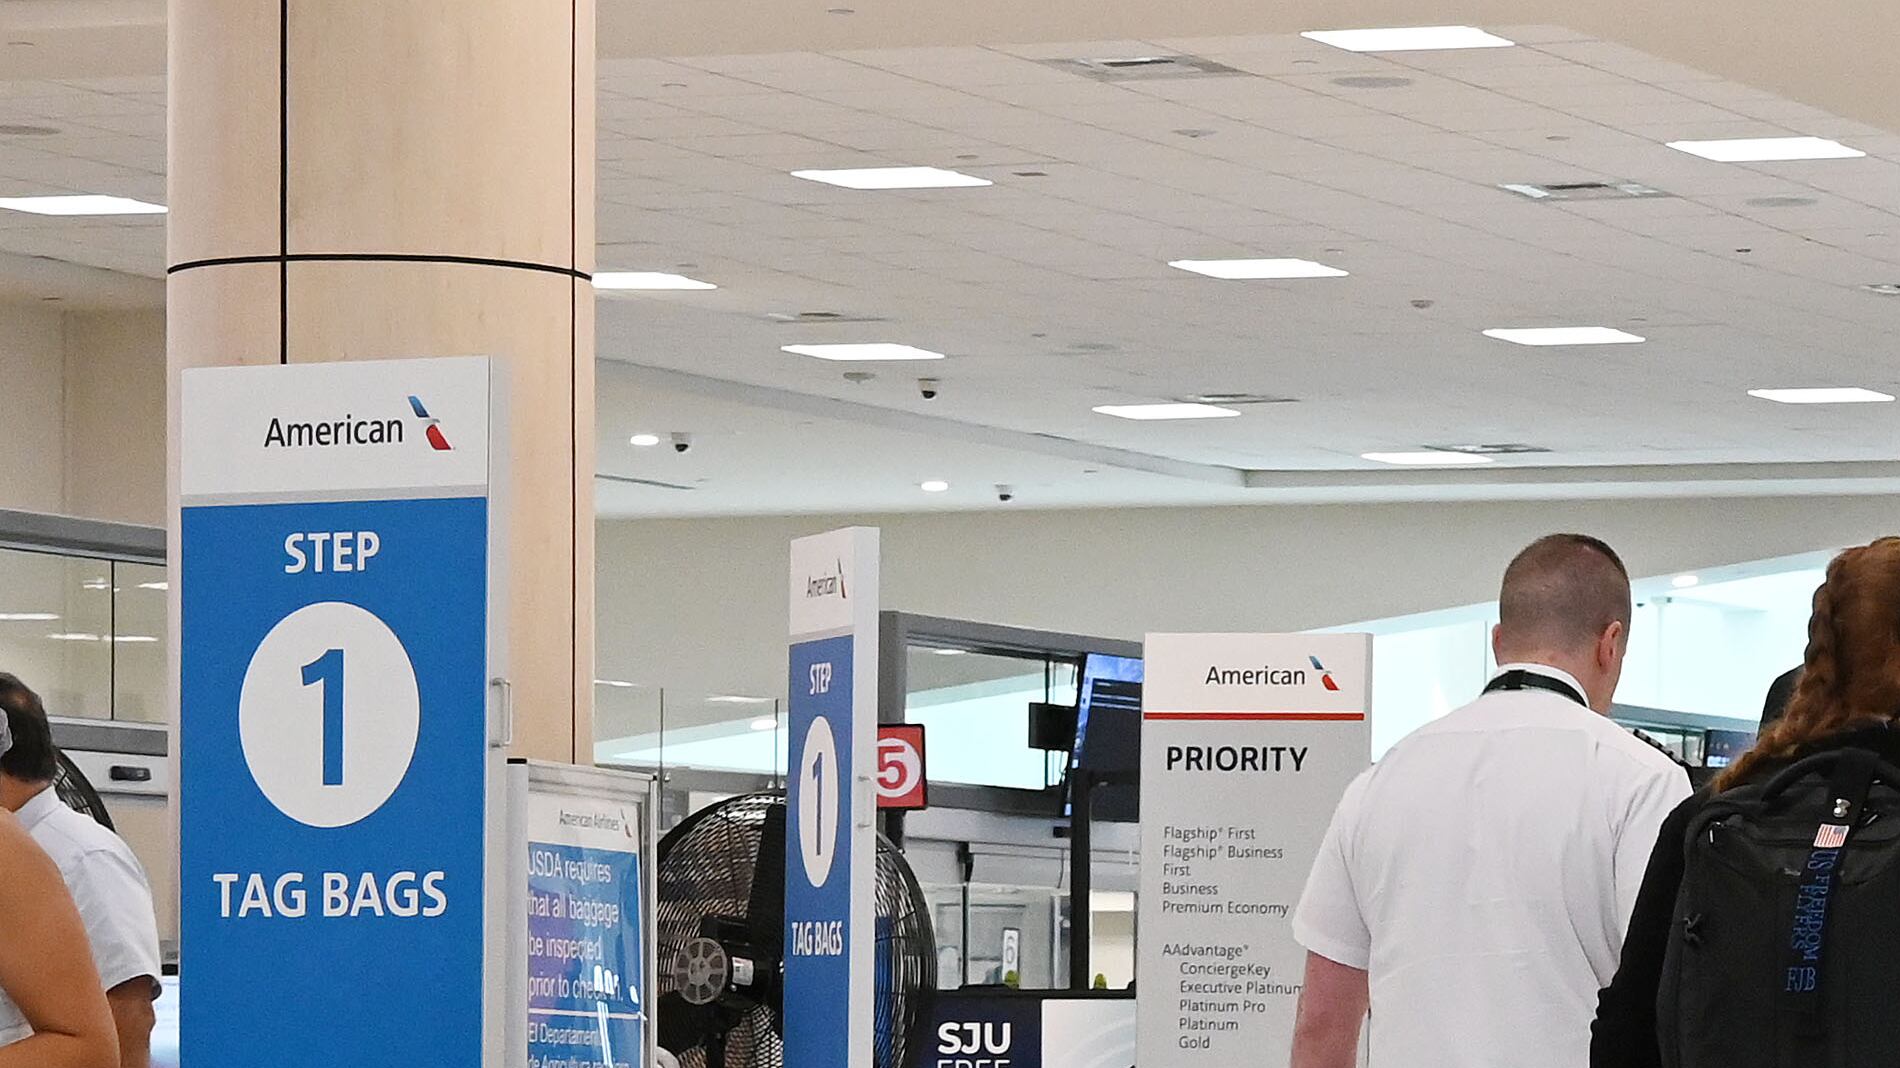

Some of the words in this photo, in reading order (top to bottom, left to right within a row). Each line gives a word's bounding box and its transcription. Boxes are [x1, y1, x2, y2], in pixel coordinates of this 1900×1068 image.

[264, 414, 404, 448] American
[284, 530, 380, 574] STEP
[807, 573, 837, 598] American
[810, 662, 832, 695] STEP
[1205, 666, 1306, 686] American
[300, 648, 345, 786] 1
[877, 746, 908, 790] 5
[1166, 746, 1308, 772] PRIORITY
[812, 751, 823, 856] 1
[559, 809, 593, 828] American
[1228, 827, 1256, 840] First
[1228, 845, 1283, 859] Business
[528, 850, 563, 878] USDA
[565, 856, 611, 885] requires
[1163, 863, 1191, 876] First
[212, 871, 307, 920] TAG
[322, 870, 448, 919] BAGS
[1163, 882, 1218, 895] Business
[552, 893, 566, 918] all
[569, 894, 619, 928] baggage
[1163, 900, 1223, 913] Premium
[1228, 901, 1289, 918] Economy
[528, 930, 543, 956] be
[547, 932, 601, 964] inspected
[792, 921, 813, 956] TAG
[814, 920, 843, 956] BAGS
[1180, 962, 1271, 979] ConciergeKey
[529, 970, 555, 998] prior
[559, 973, 570, 998] to
[1180, 980, 1242, 994] Executive
[1180, 1000, 1239, 1013] Platinum
[1243, 1000, 1266, 1013] Pro
[1179, 1018, 1239, 1030] Platinum
[937, 1022, 1012, 1055] SJU
[1179, 1036, 1210, 1049] Gold
